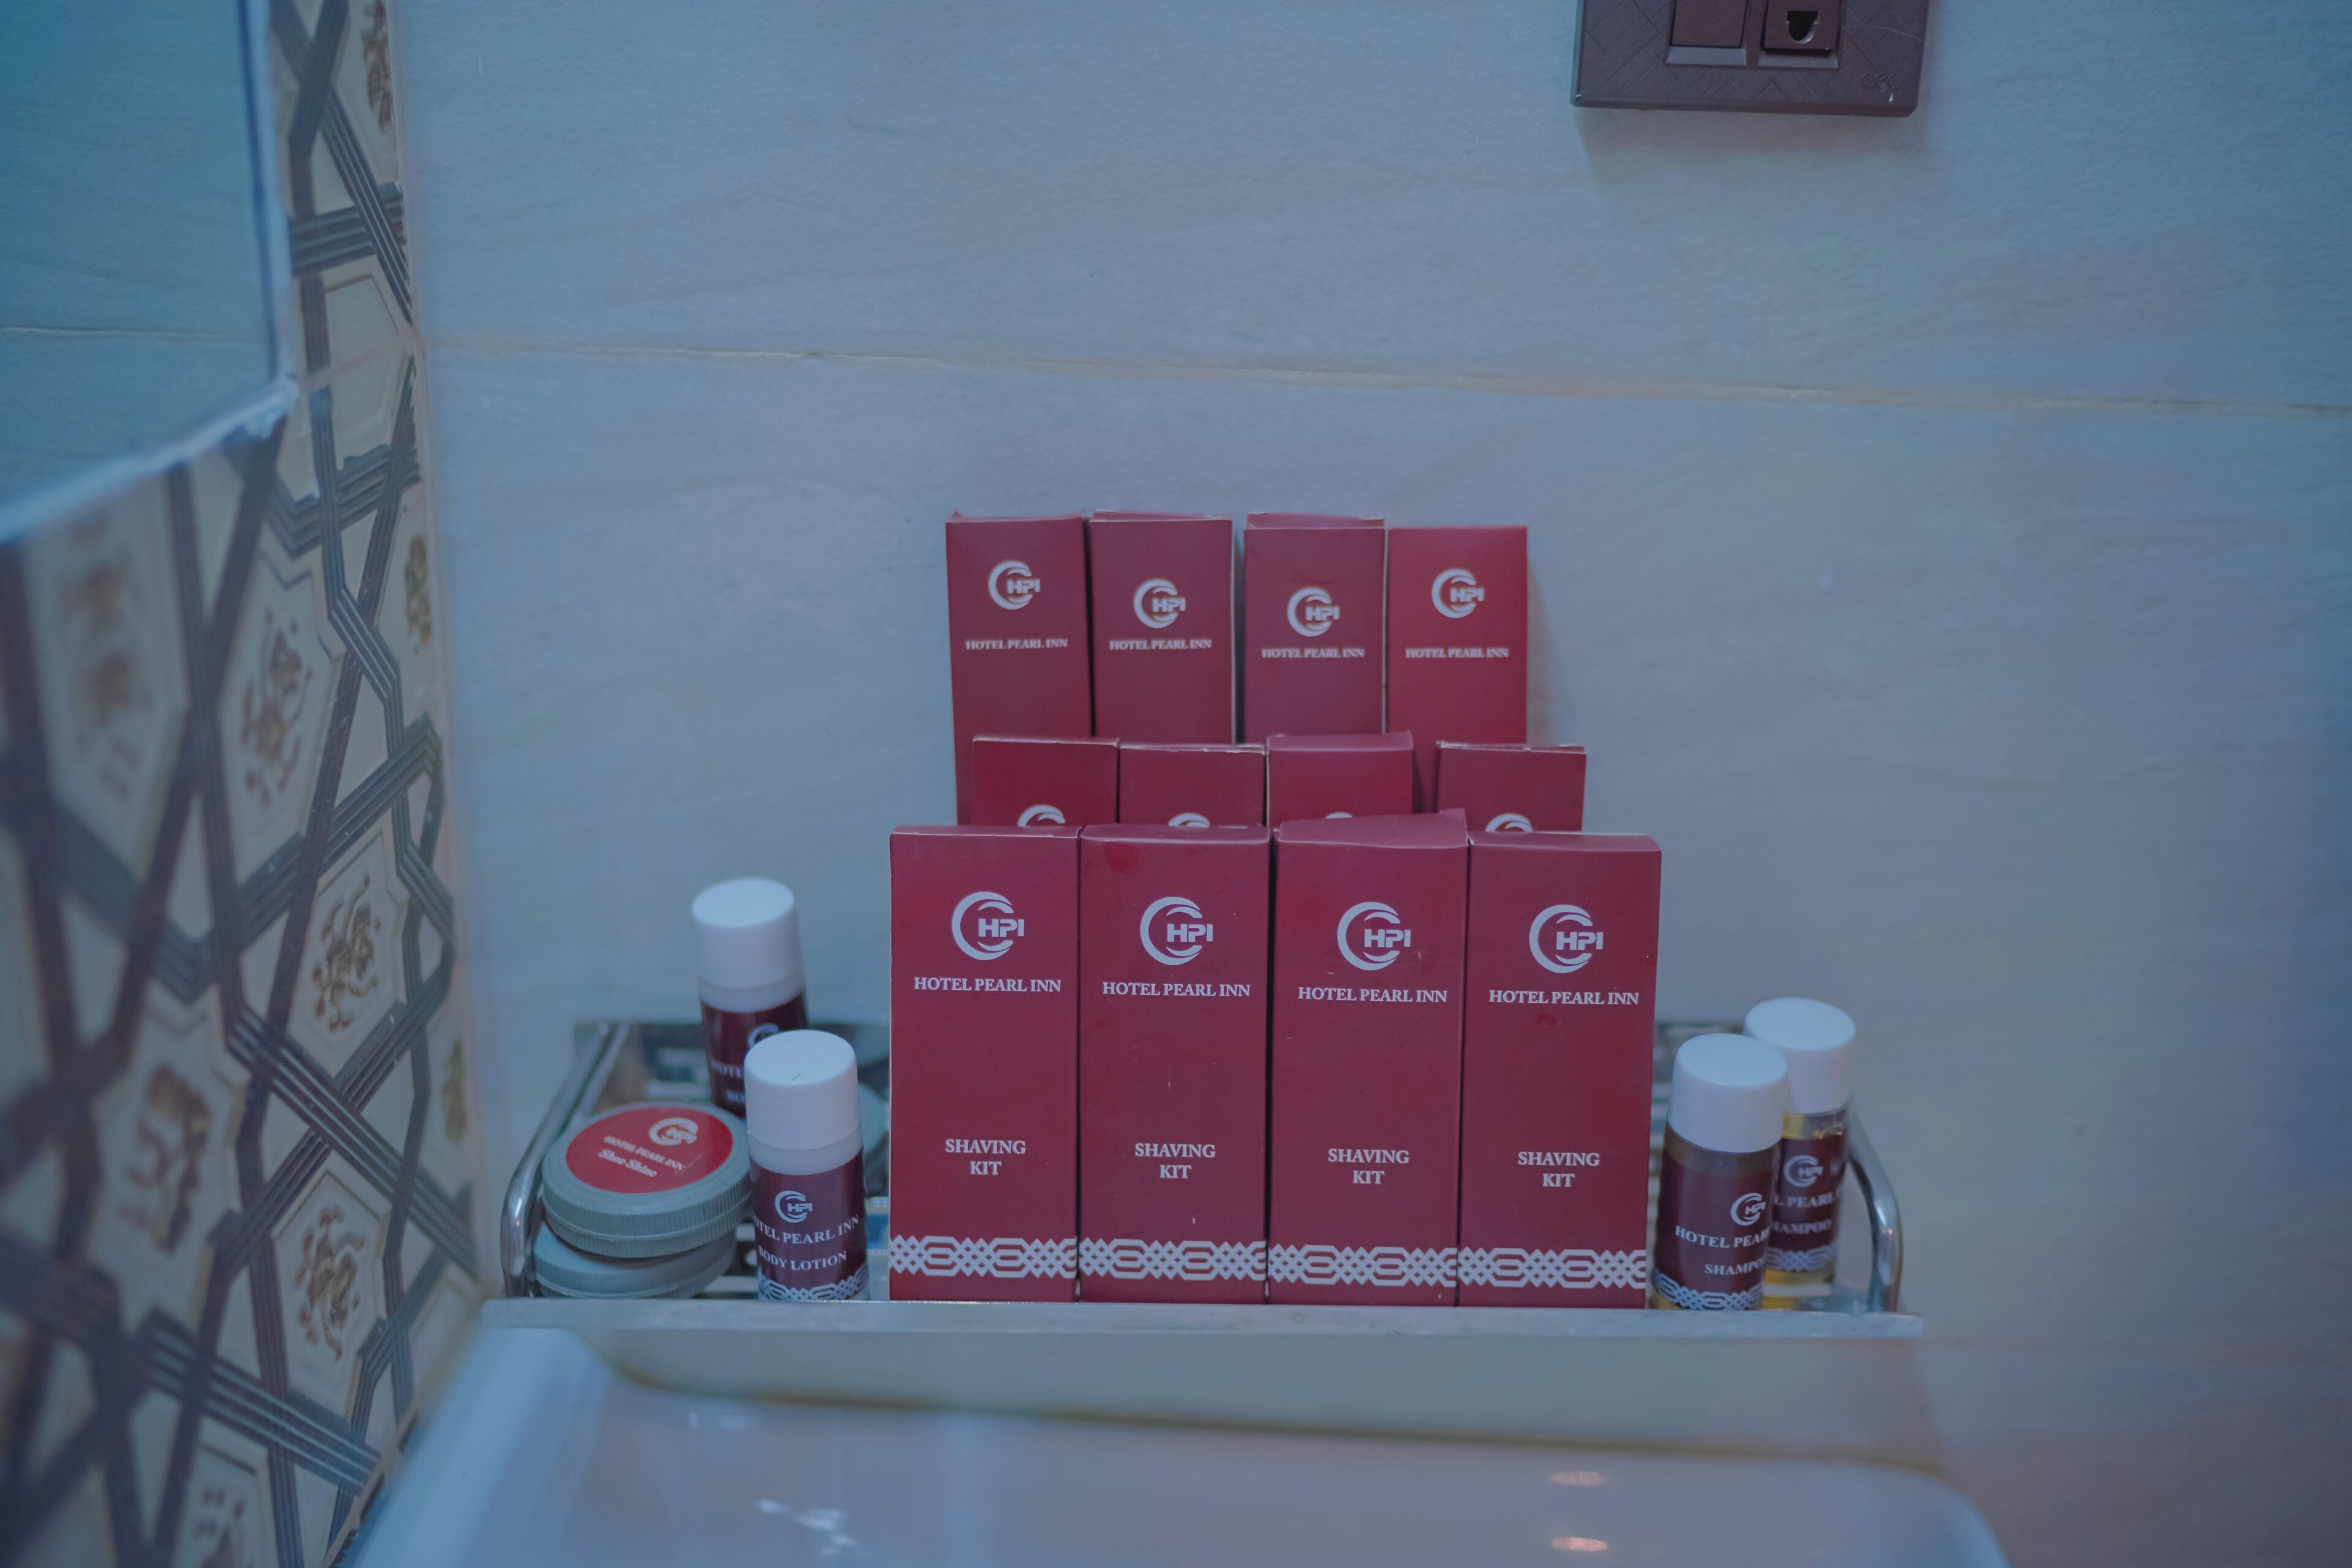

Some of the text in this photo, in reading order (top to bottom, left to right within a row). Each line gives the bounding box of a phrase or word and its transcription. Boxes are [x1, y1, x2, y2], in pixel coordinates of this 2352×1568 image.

[965, 638, 1068, 650] HOTEL PEARL INN
[1109, 639, 1212, 650] HOTEL PEARL INN
[1262, 648, 1365, 658] HOTEL PEARL INN
[1405, 647, 1509, 658] HOTEL PEARL INN
[978, 918, 1024, 937] HPI
[1167, 923, 1213, 943] HPI
[1364, 929, 1411, 948] HPI
[1556, 932, 1604, 951] HPI
[914, 977, 1061, 992] HOTEL PEARL INN
[1102, 981, 1251, 997] HOTEL PEARL INN
[1298, 987, 1447, 1003] HOTEL PEARL INN
[1489, 990, 1639, 1005] HOTEL PEARL INN
[945, 1139, 1027, 1155] SHAVING
[1135, 1142, 1216, 1158] SHAVING
[598, 1148, 657, 1177] Shoe Shine
[1328, 1148, 1409, 1164] SHAVING
[1518, 1151, 1600, 1167] SHAVING
[970, 1161, 1002, 1175] KIT
[1159, 1164, 1192, 1179] KIT
[1352, 1170, 1385, 1185] KIT
[1542, 1173, 1575, 1187] KIT
[788, 1203, 813, 1212] HPI
[1787, 1192, 1834, 1208] PEARL
[754, 1214, 859, 1244] OTEL PEARL INN
[1675, 1225, 1769, 1248] HOTEL PEAR
[758, 1245, 846, 1270] BODY LOTION
[1705, 1257, 1765, 1275] SHAMPO
